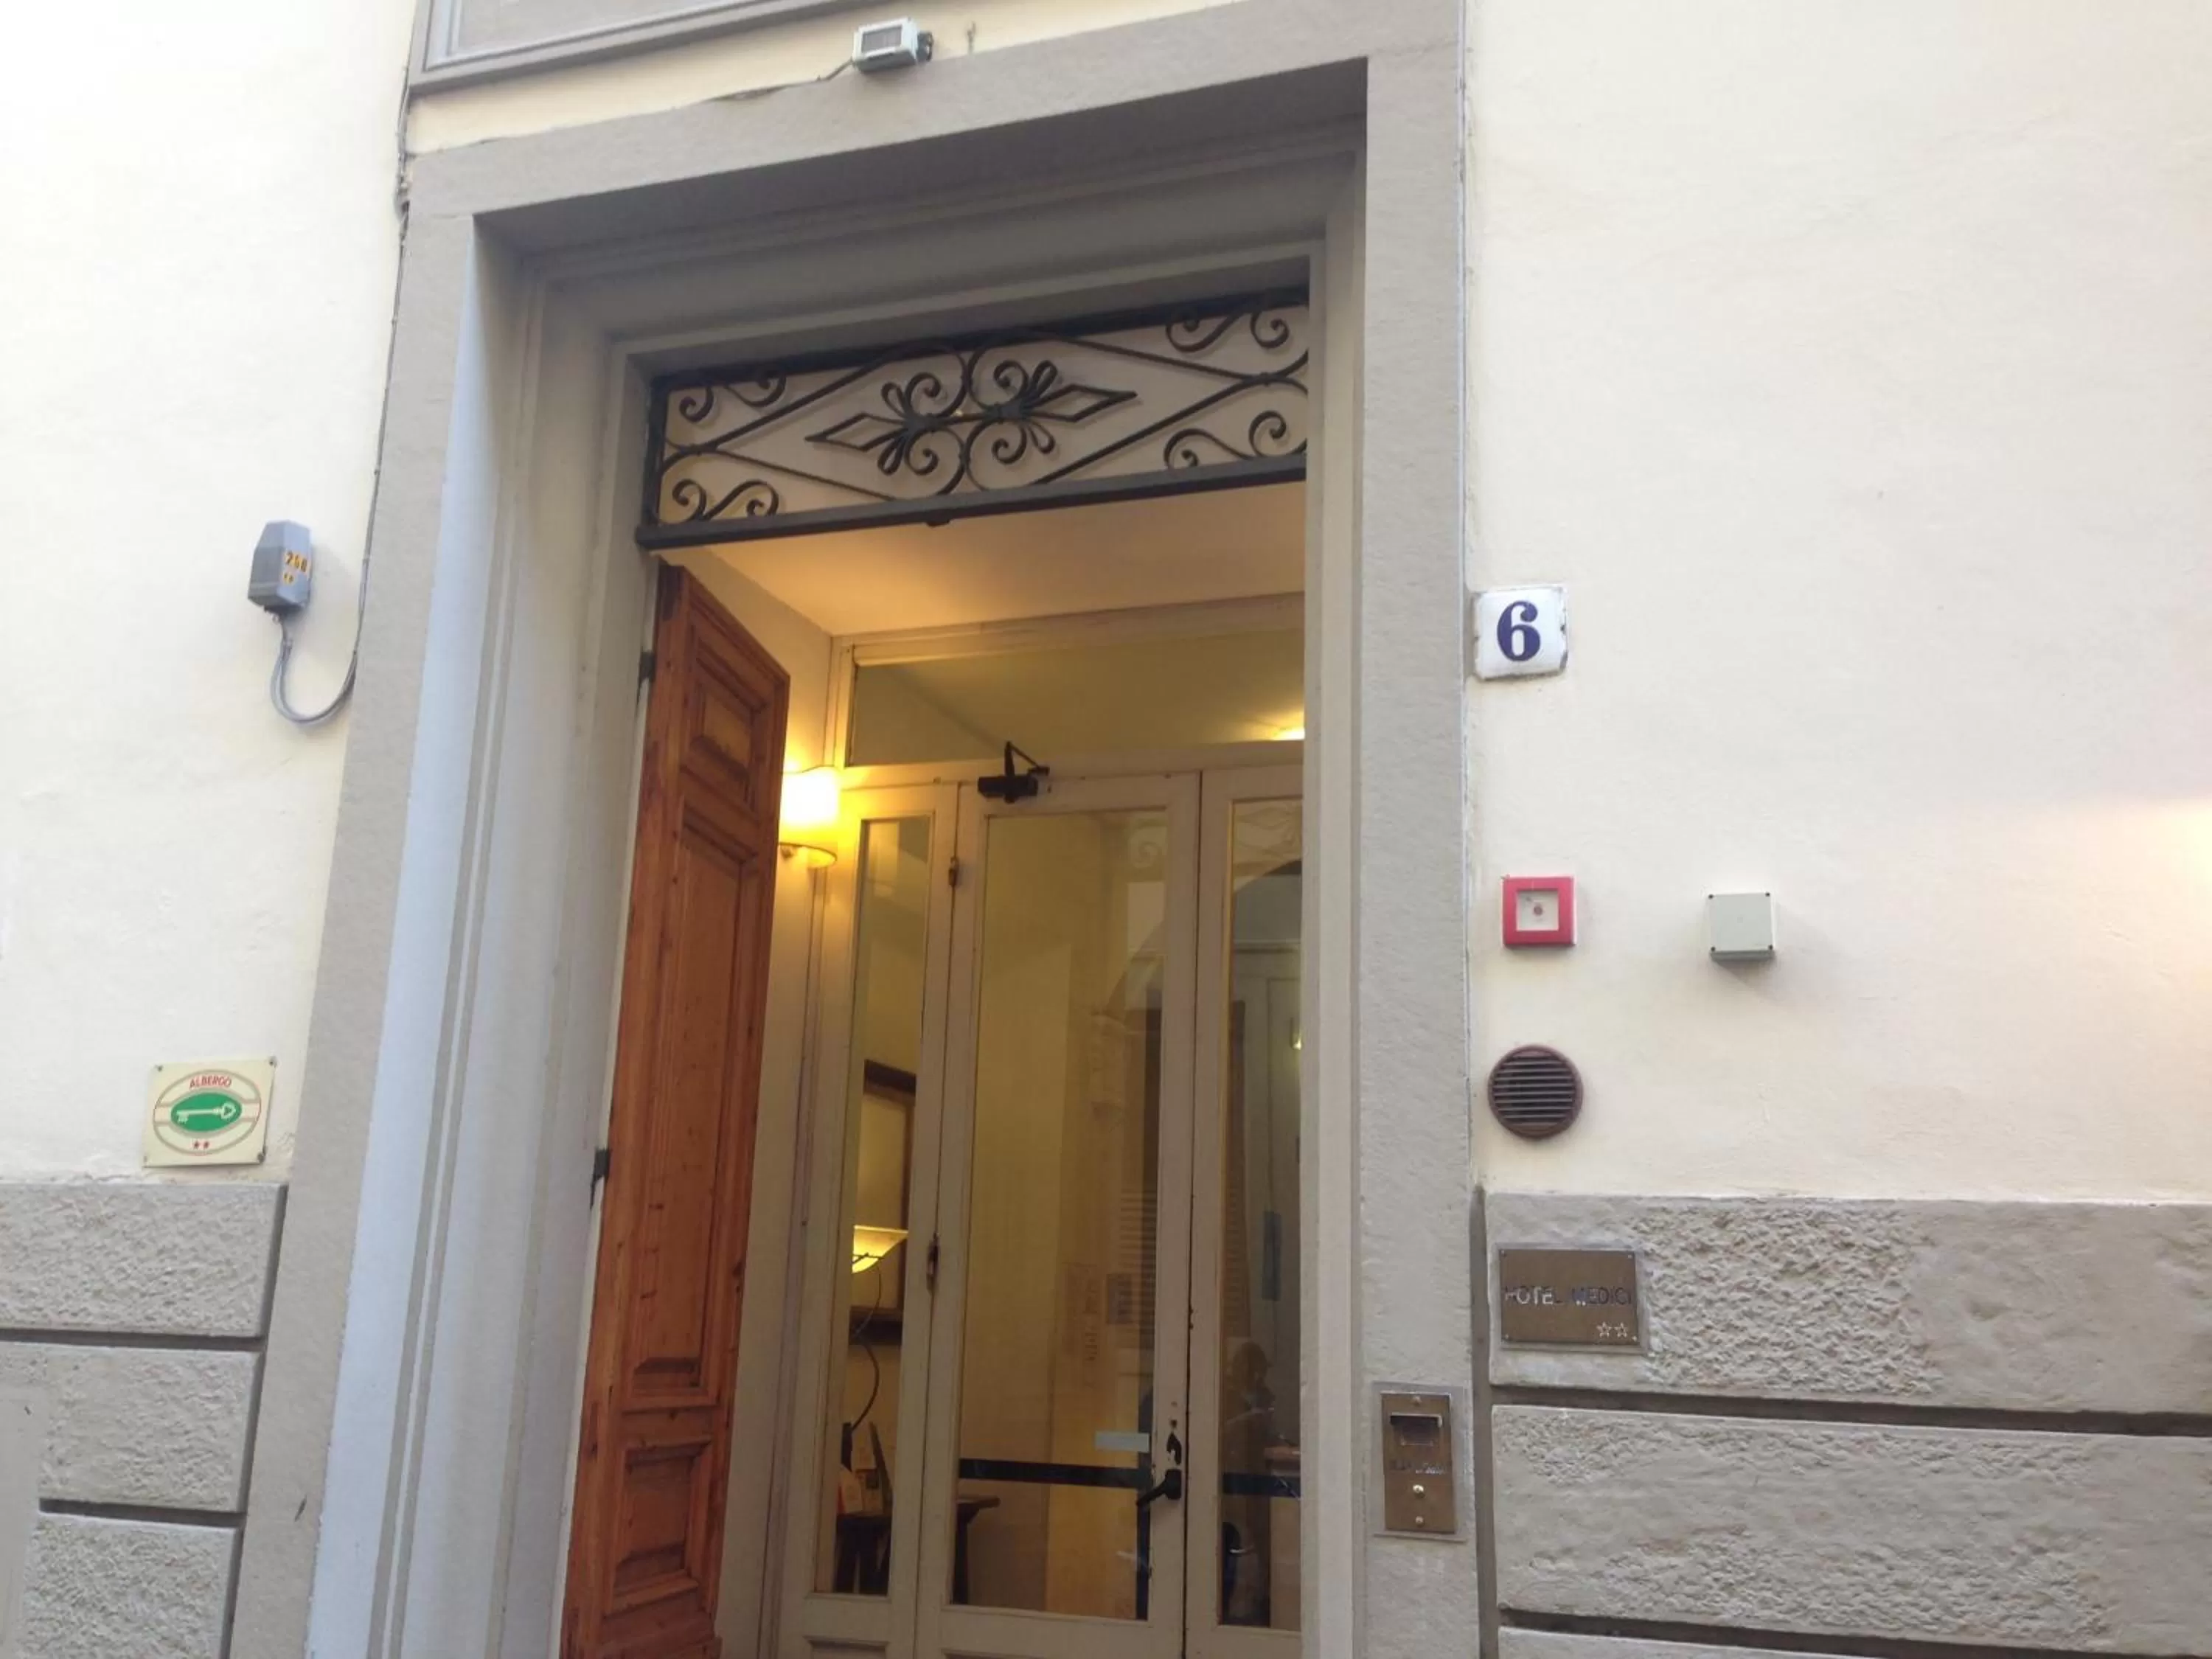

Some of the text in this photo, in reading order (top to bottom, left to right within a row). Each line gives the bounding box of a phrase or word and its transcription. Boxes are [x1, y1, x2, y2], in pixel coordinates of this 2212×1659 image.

[1497, 600, 1541, 662] 6
[189, 1076, 232, 1088] ALBERGO
[1504, 1286, 1632, 1305] HOTEL MEDICI
